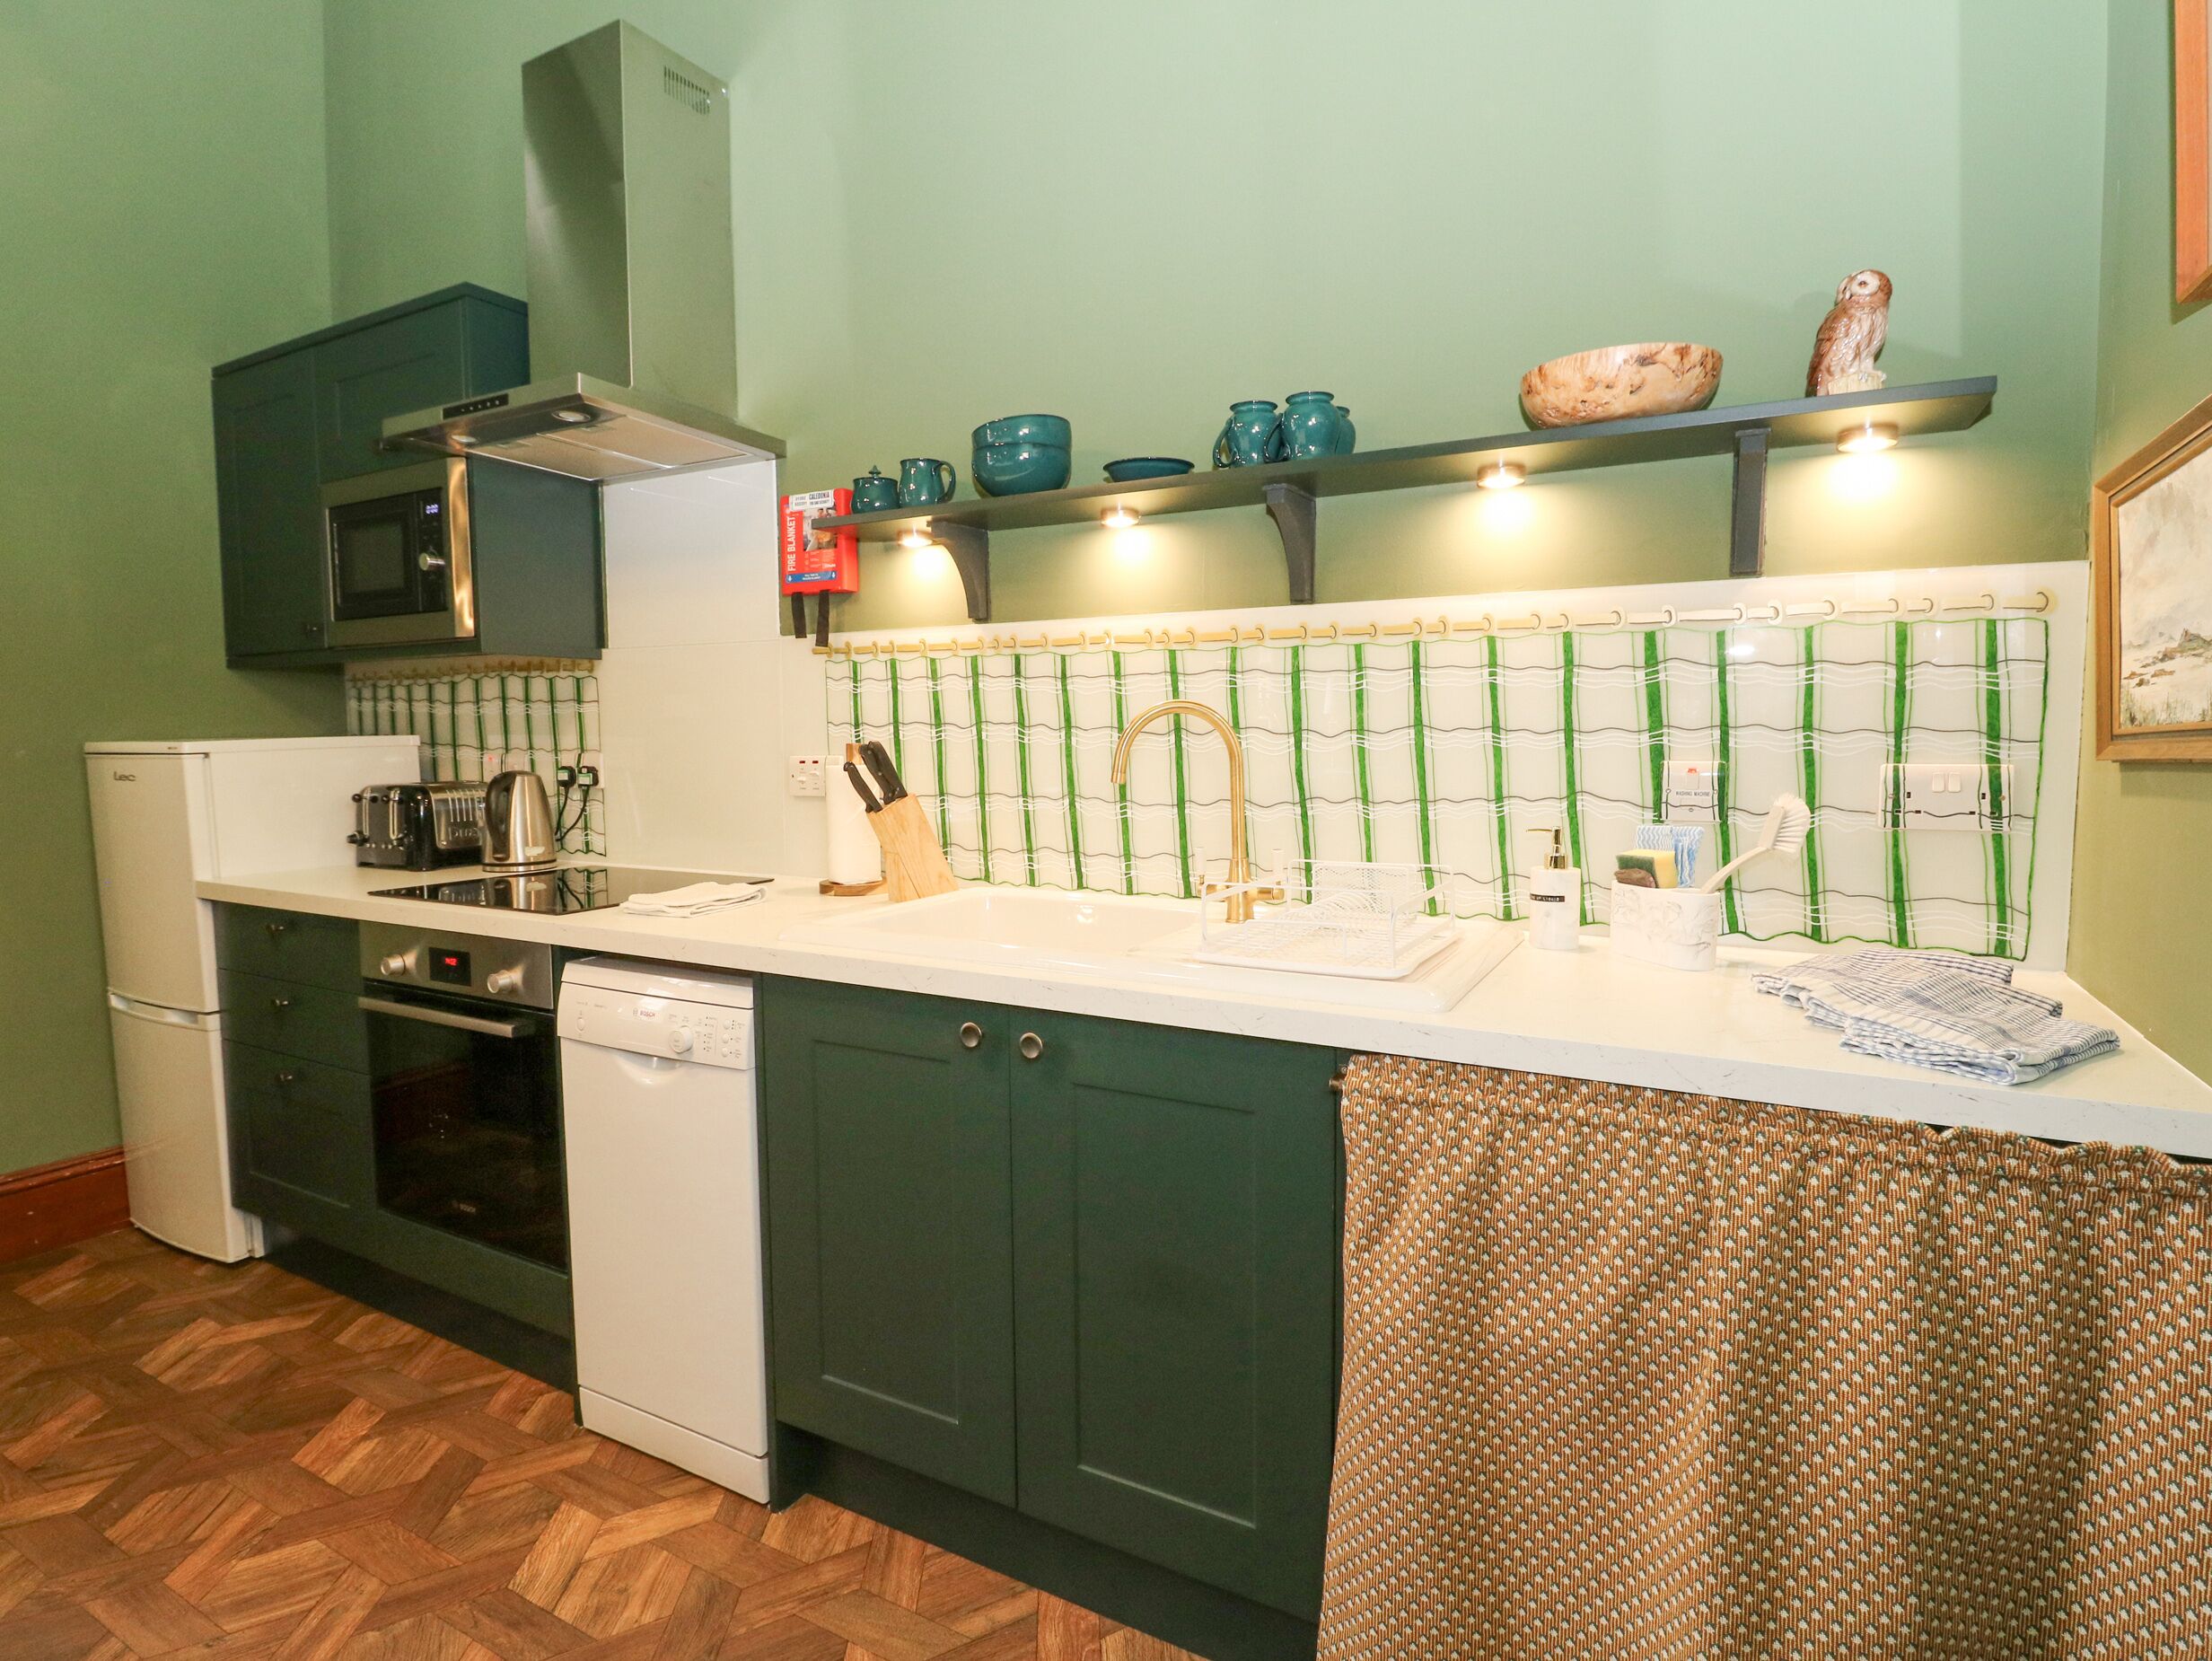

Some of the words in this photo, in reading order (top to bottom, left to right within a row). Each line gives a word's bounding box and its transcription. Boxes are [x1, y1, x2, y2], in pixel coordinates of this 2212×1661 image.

[809, 492, 830, 500] CALEDONIA
[787, 517, 796, 552] BLANKET
[787, 553, 796, 572] FIRE
[113, 771, 136, 782] Lec
